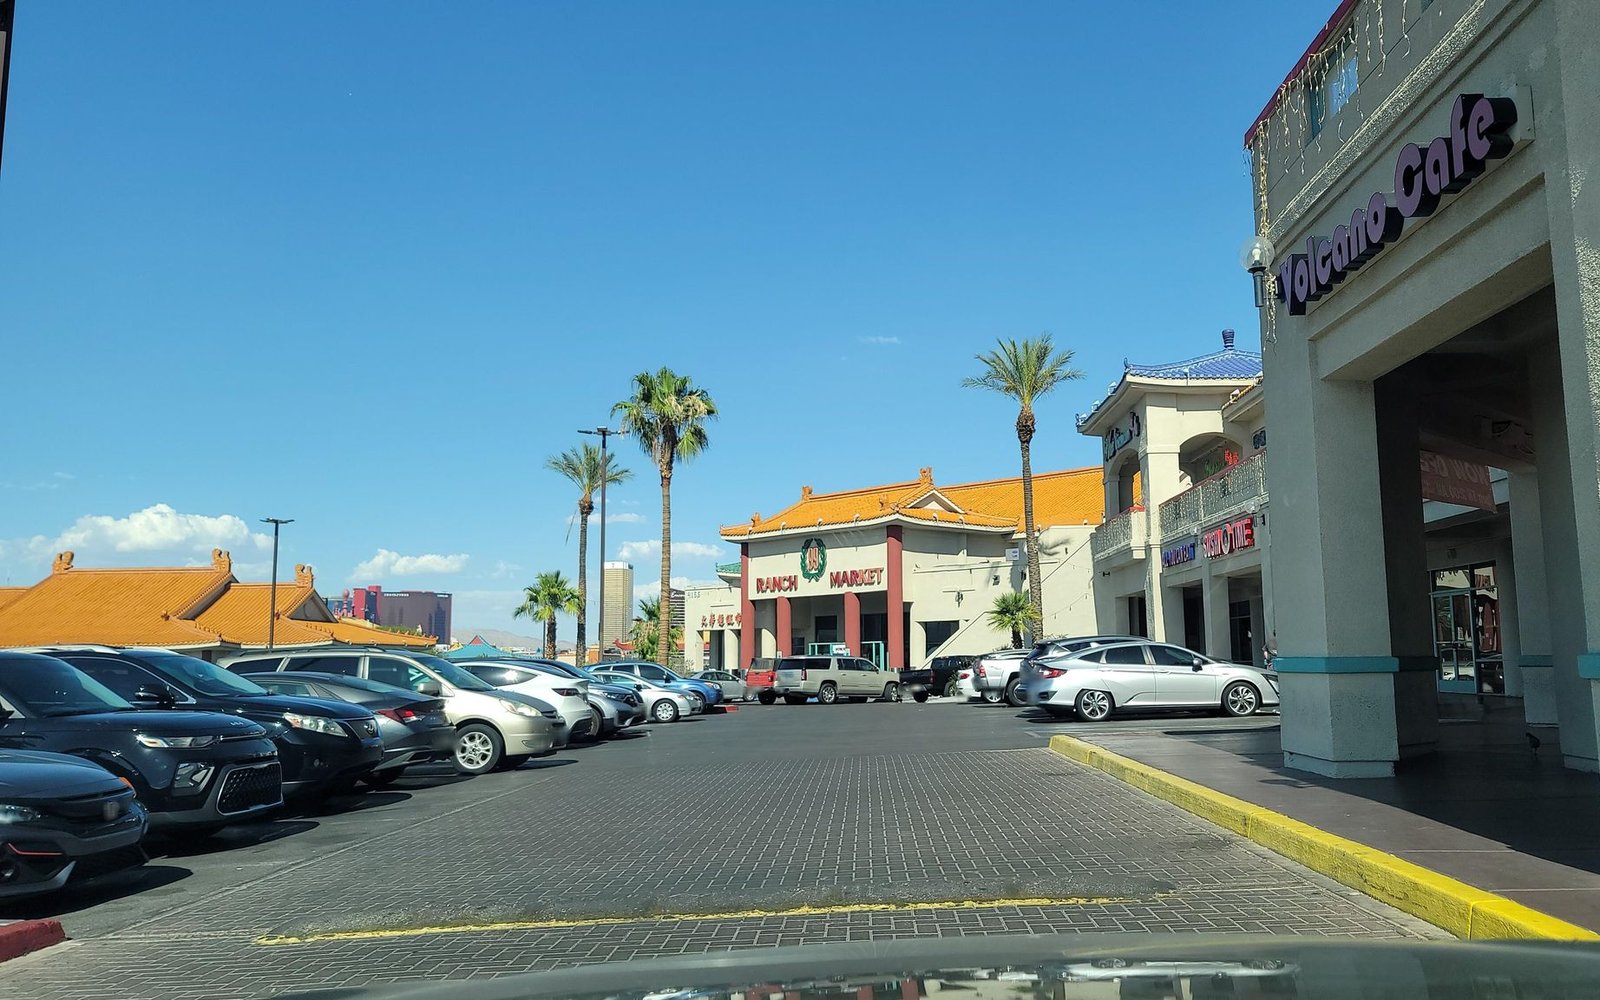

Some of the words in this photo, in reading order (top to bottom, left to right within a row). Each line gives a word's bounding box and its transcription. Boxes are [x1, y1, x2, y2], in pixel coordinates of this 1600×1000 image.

[1280, 191, 1398, 316] Volcano
[1394, 93, 1510, 218] Cafe
[808, 547, 819, 571] 99
[756, 575, 798, 594] RANCH
[830, 567, 884, 589] MARKET
